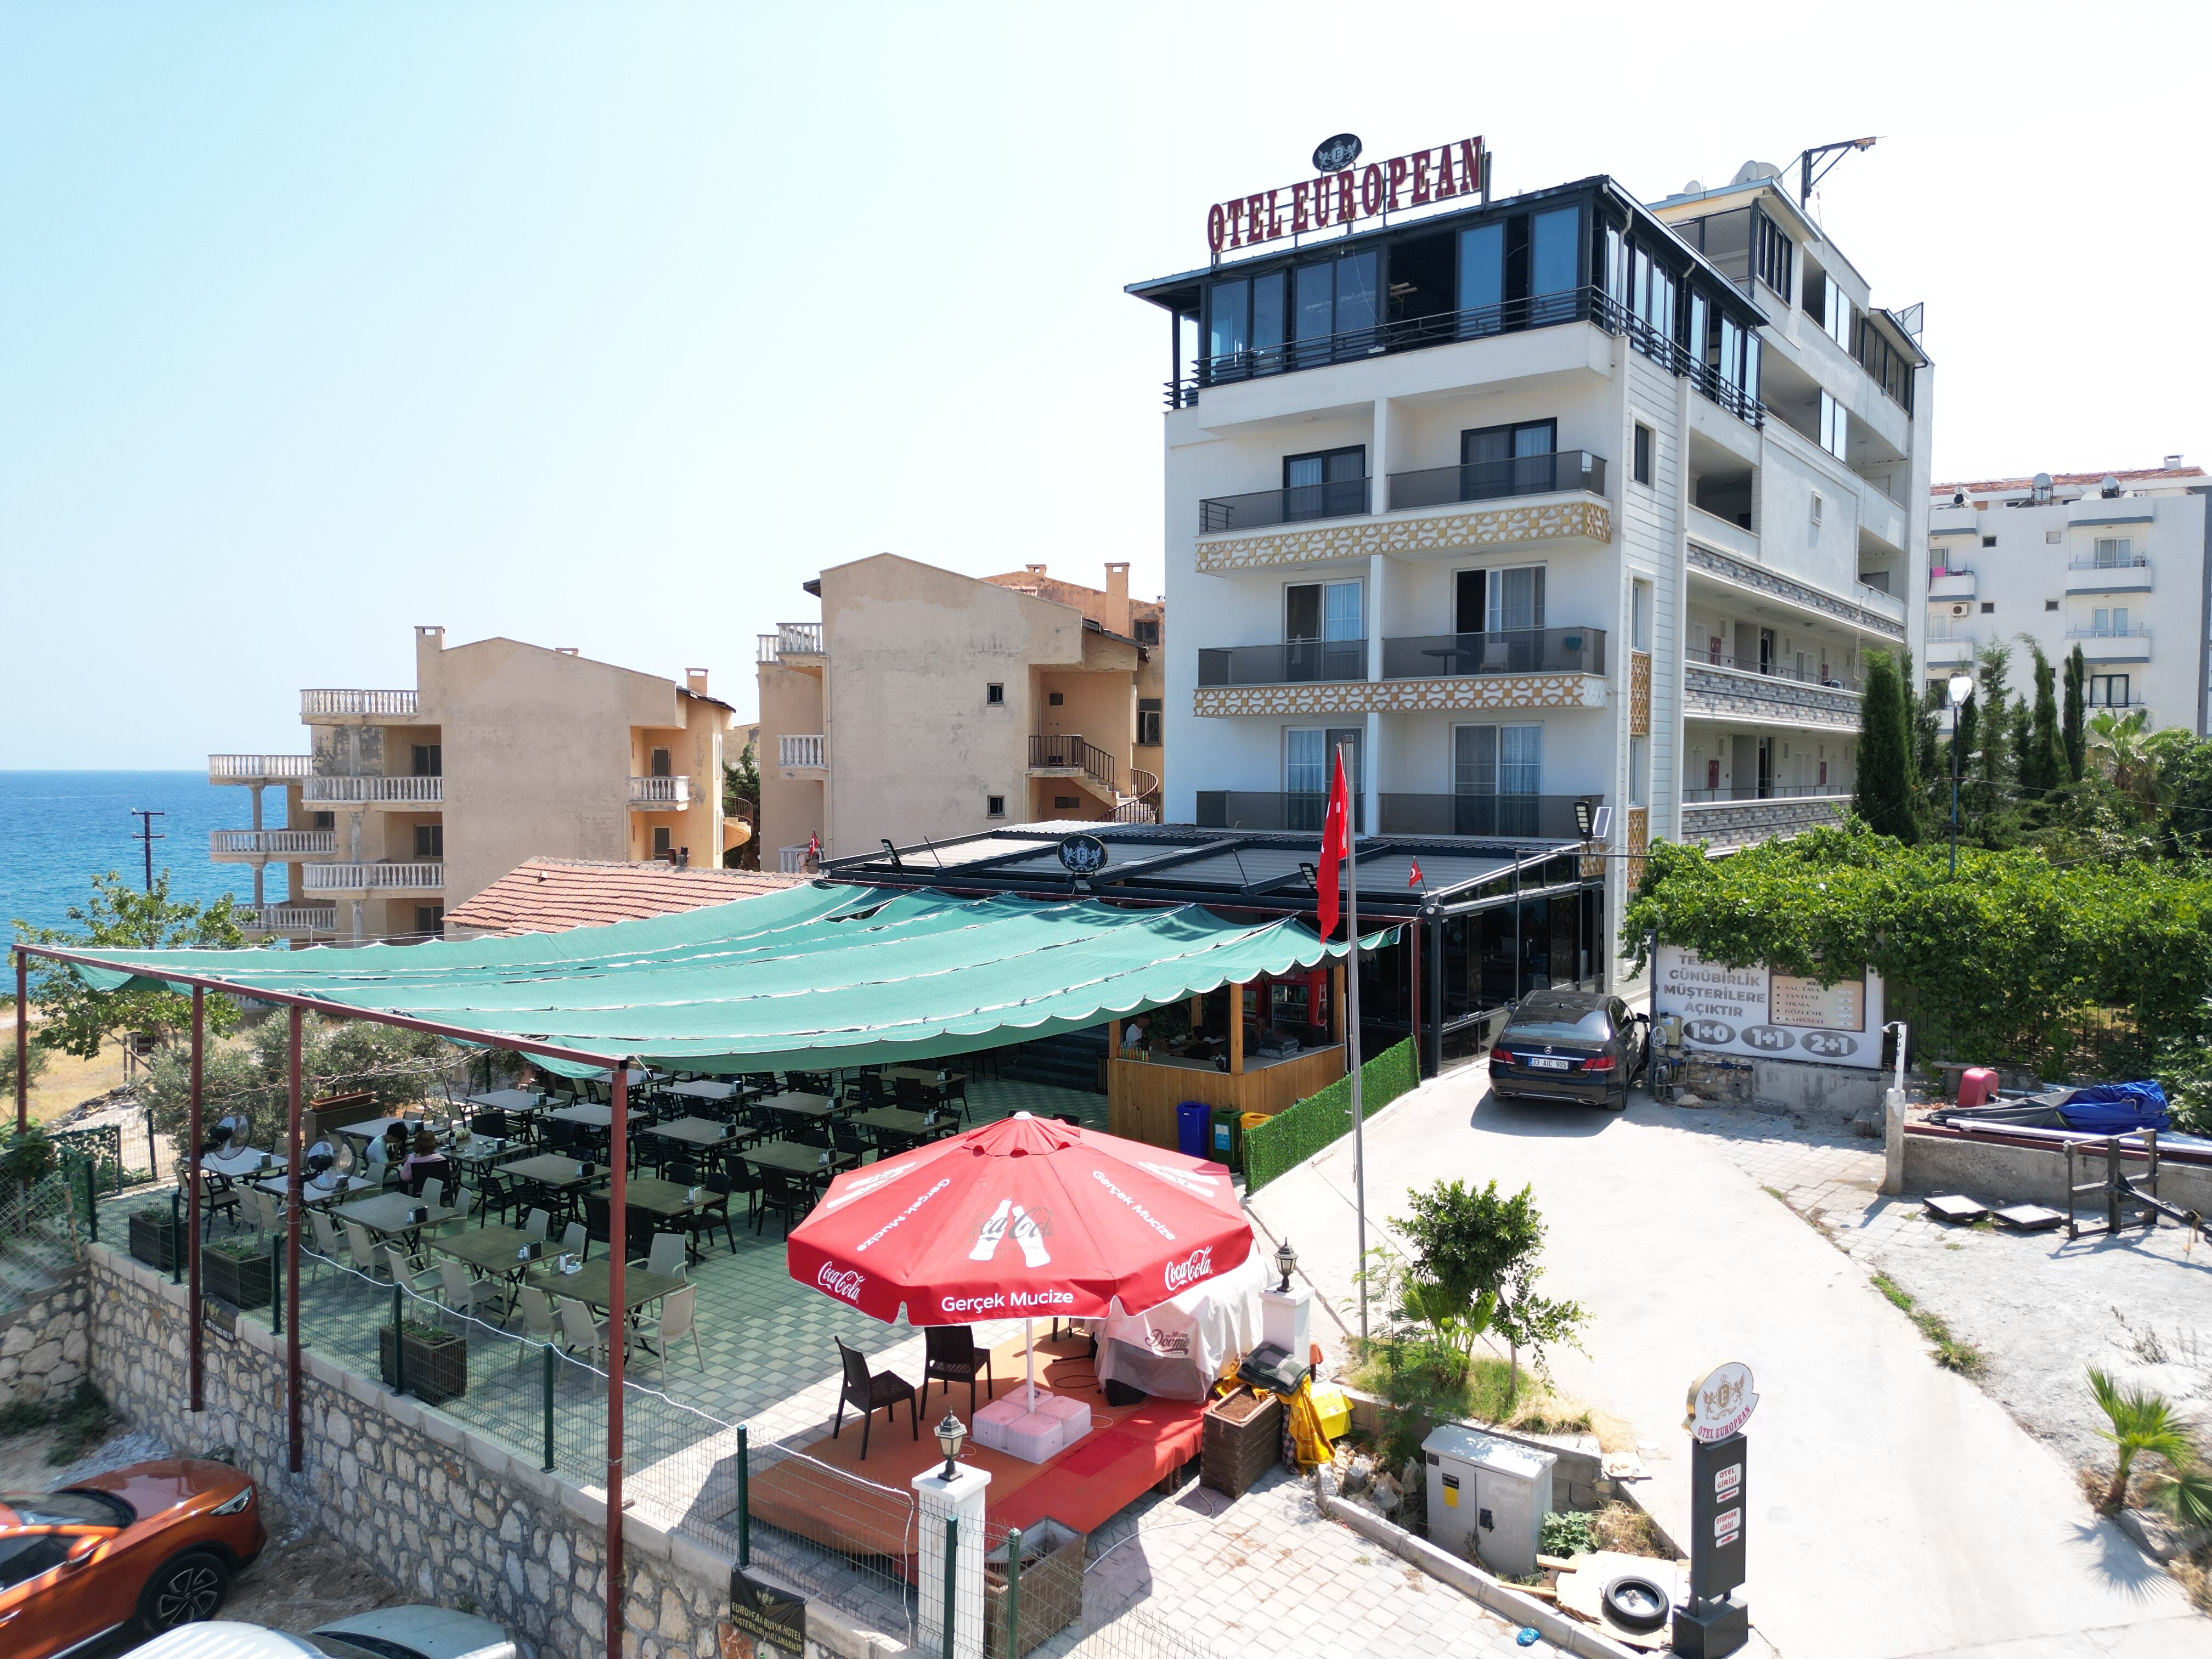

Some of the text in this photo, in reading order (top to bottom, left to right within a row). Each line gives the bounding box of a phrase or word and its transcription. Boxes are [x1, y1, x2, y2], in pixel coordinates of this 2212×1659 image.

[1335, 149, 1341, 160] E
[1207, 135, 1485, 253] OTEL EUROPEAN
[1080, 850, 1086, 861] E
[1669, 968, 1760, 986] GÜNÜBİRLİK
[1664, 983, 1765, 1003] MÜŞTERİLERE
[1684, 1002, 1743, 1017] AÇIKTIR
[1691, 1023, 1728, 1042] 1+0
[1752, 1029, 1784, 1048] 1+1
[1810, 1035, 1848, 1054] 2+1
[904, 1178, 951, 1215] Gerçek
[1092, 1171, 1134, 1205] Gerçek
[1132, 1205, 1175, 1240] Mucize
[856, 1216, 906, 1251] Mucize
[1165, 1246, 1212, 1291] Coca-Cola
[817, 1261, 866, 1300] Coca-Cola
[941, 1289, 1074, 1313] Gerçek Mucize
[1721, 1389, 1728, 1403] E
[1698, 1405, 1750, 1438] OTEL EUROPEAN
[1717, 1474, 1736, 1488] GİRİŞİ
[1719, 1468, 1735, 1478] OTEL
[1716, 1510, 1737, 1525] OTOPARK
[783, 1625, 802, 1641] HOTEL
